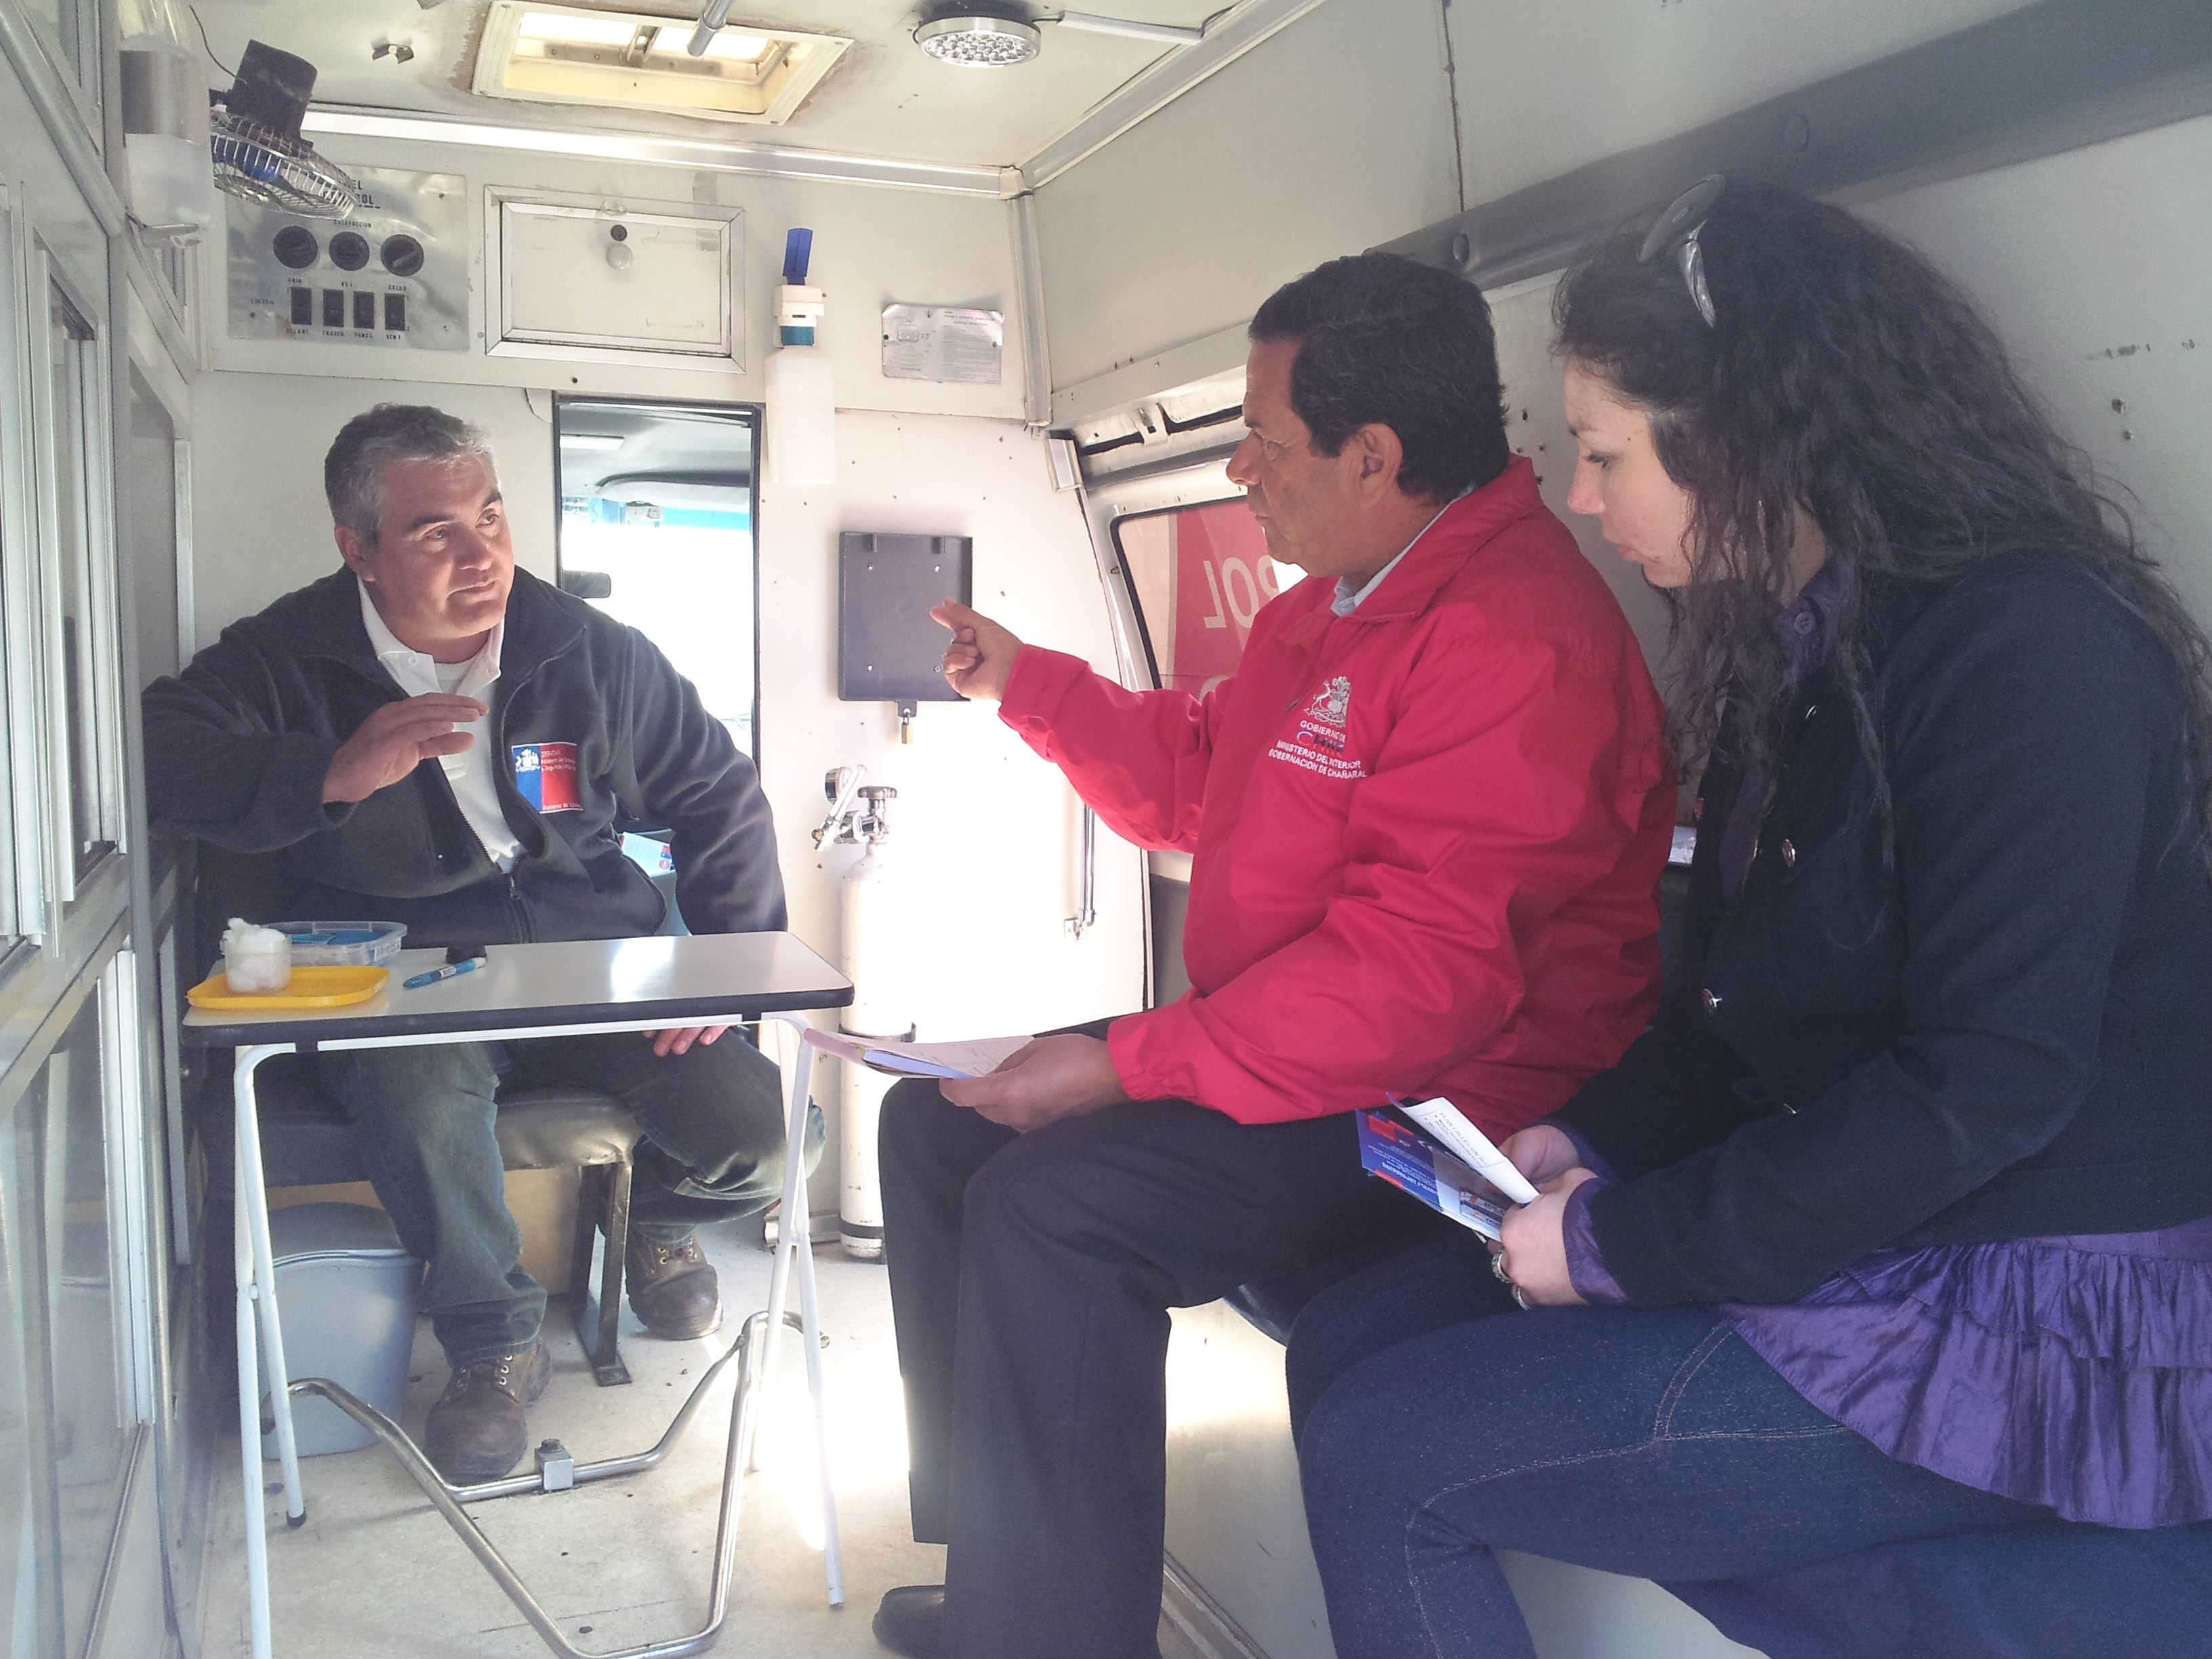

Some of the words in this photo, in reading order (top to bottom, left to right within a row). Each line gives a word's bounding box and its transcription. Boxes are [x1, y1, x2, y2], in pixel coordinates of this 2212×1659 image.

[1299, 720, 1339, 740] GOBIERNO
[1268, 748, 1317, 773] GOBERNACION
[1317, 764, 1327, 775] DE
[1327, 767, 1368, 779] CHAÑARAL
[1276, 739, 1316, 760] MINISTERIO
[1316, 753, 1328, 765] DEL
[1328, 757, 1361, 769] INTERIOR
